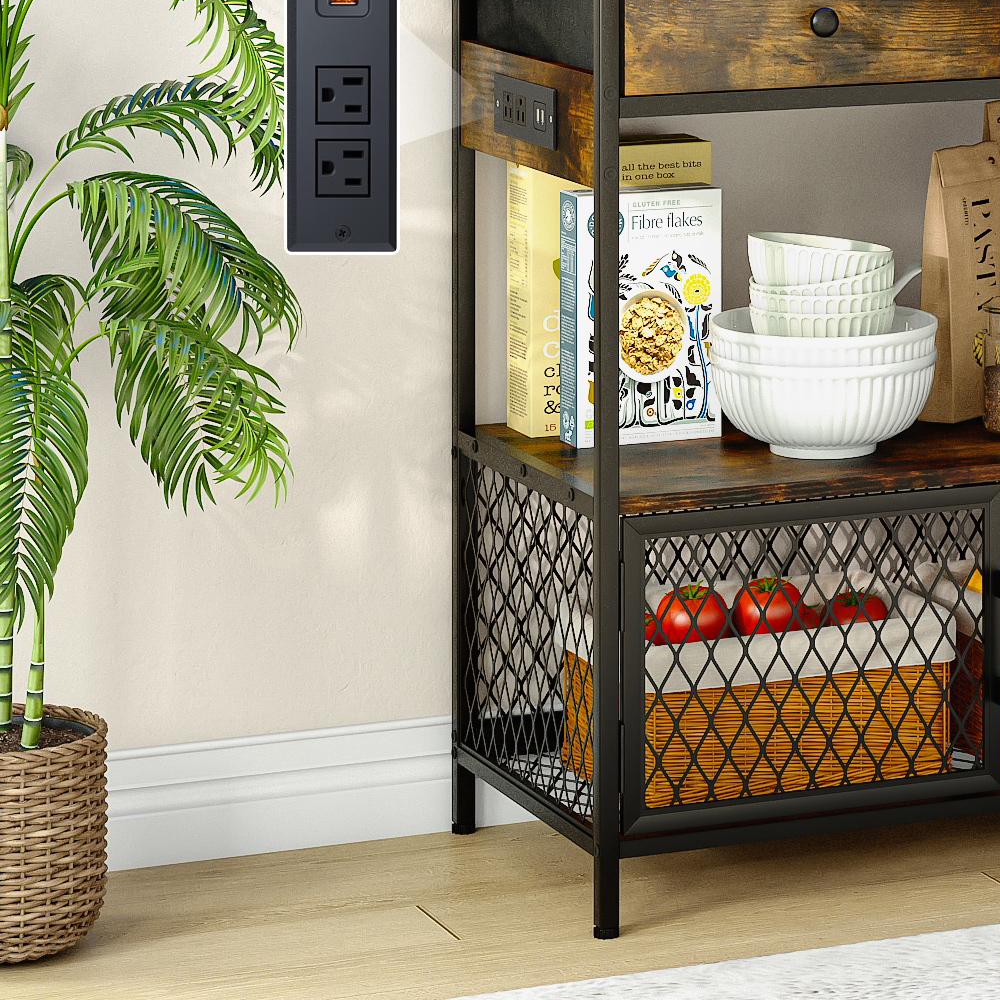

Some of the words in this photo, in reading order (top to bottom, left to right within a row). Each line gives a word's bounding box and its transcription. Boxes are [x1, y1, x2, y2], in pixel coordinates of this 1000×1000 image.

[621, 163, 635, 172] all
[637, 163, 656, 171] the
[658, 161, 680, 170] best
[682, 160, 702, 168] bits
[622, 173, 633, 181] in
[634, 172, 654, 181] one
[656, 171, 675, 179] box
[631, 213, 663, 230] Fibre
[667, 211, 703, 228] flakes
